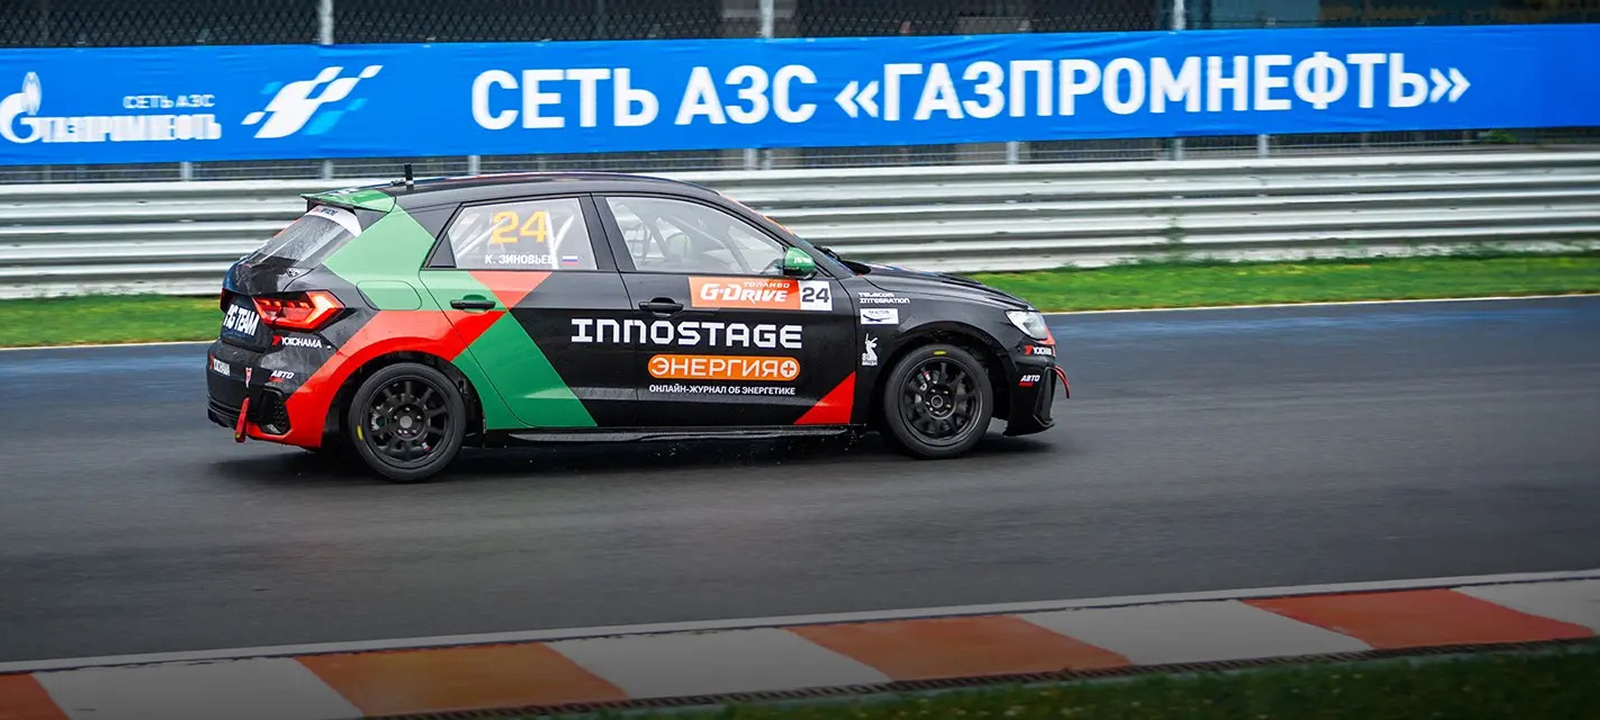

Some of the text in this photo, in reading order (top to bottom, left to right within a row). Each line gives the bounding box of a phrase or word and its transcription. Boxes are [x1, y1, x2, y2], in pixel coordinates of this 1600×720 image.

[473, 50, 1471, 130] СЕТЬ АЗС «ГАЗПРОМНЕФТЬ»
[122, 94, 215, 109] СЕТЬ АЗС
[492, 211, 547, 244] 24
[801, 287, 830, 303] 24
[234, 307, 260, 336] TEAM
[648, 383, 796, 396] ОНЛАЙН-ЖУРНАЛ ОБ ЭНЕРГЕТИКЕ
